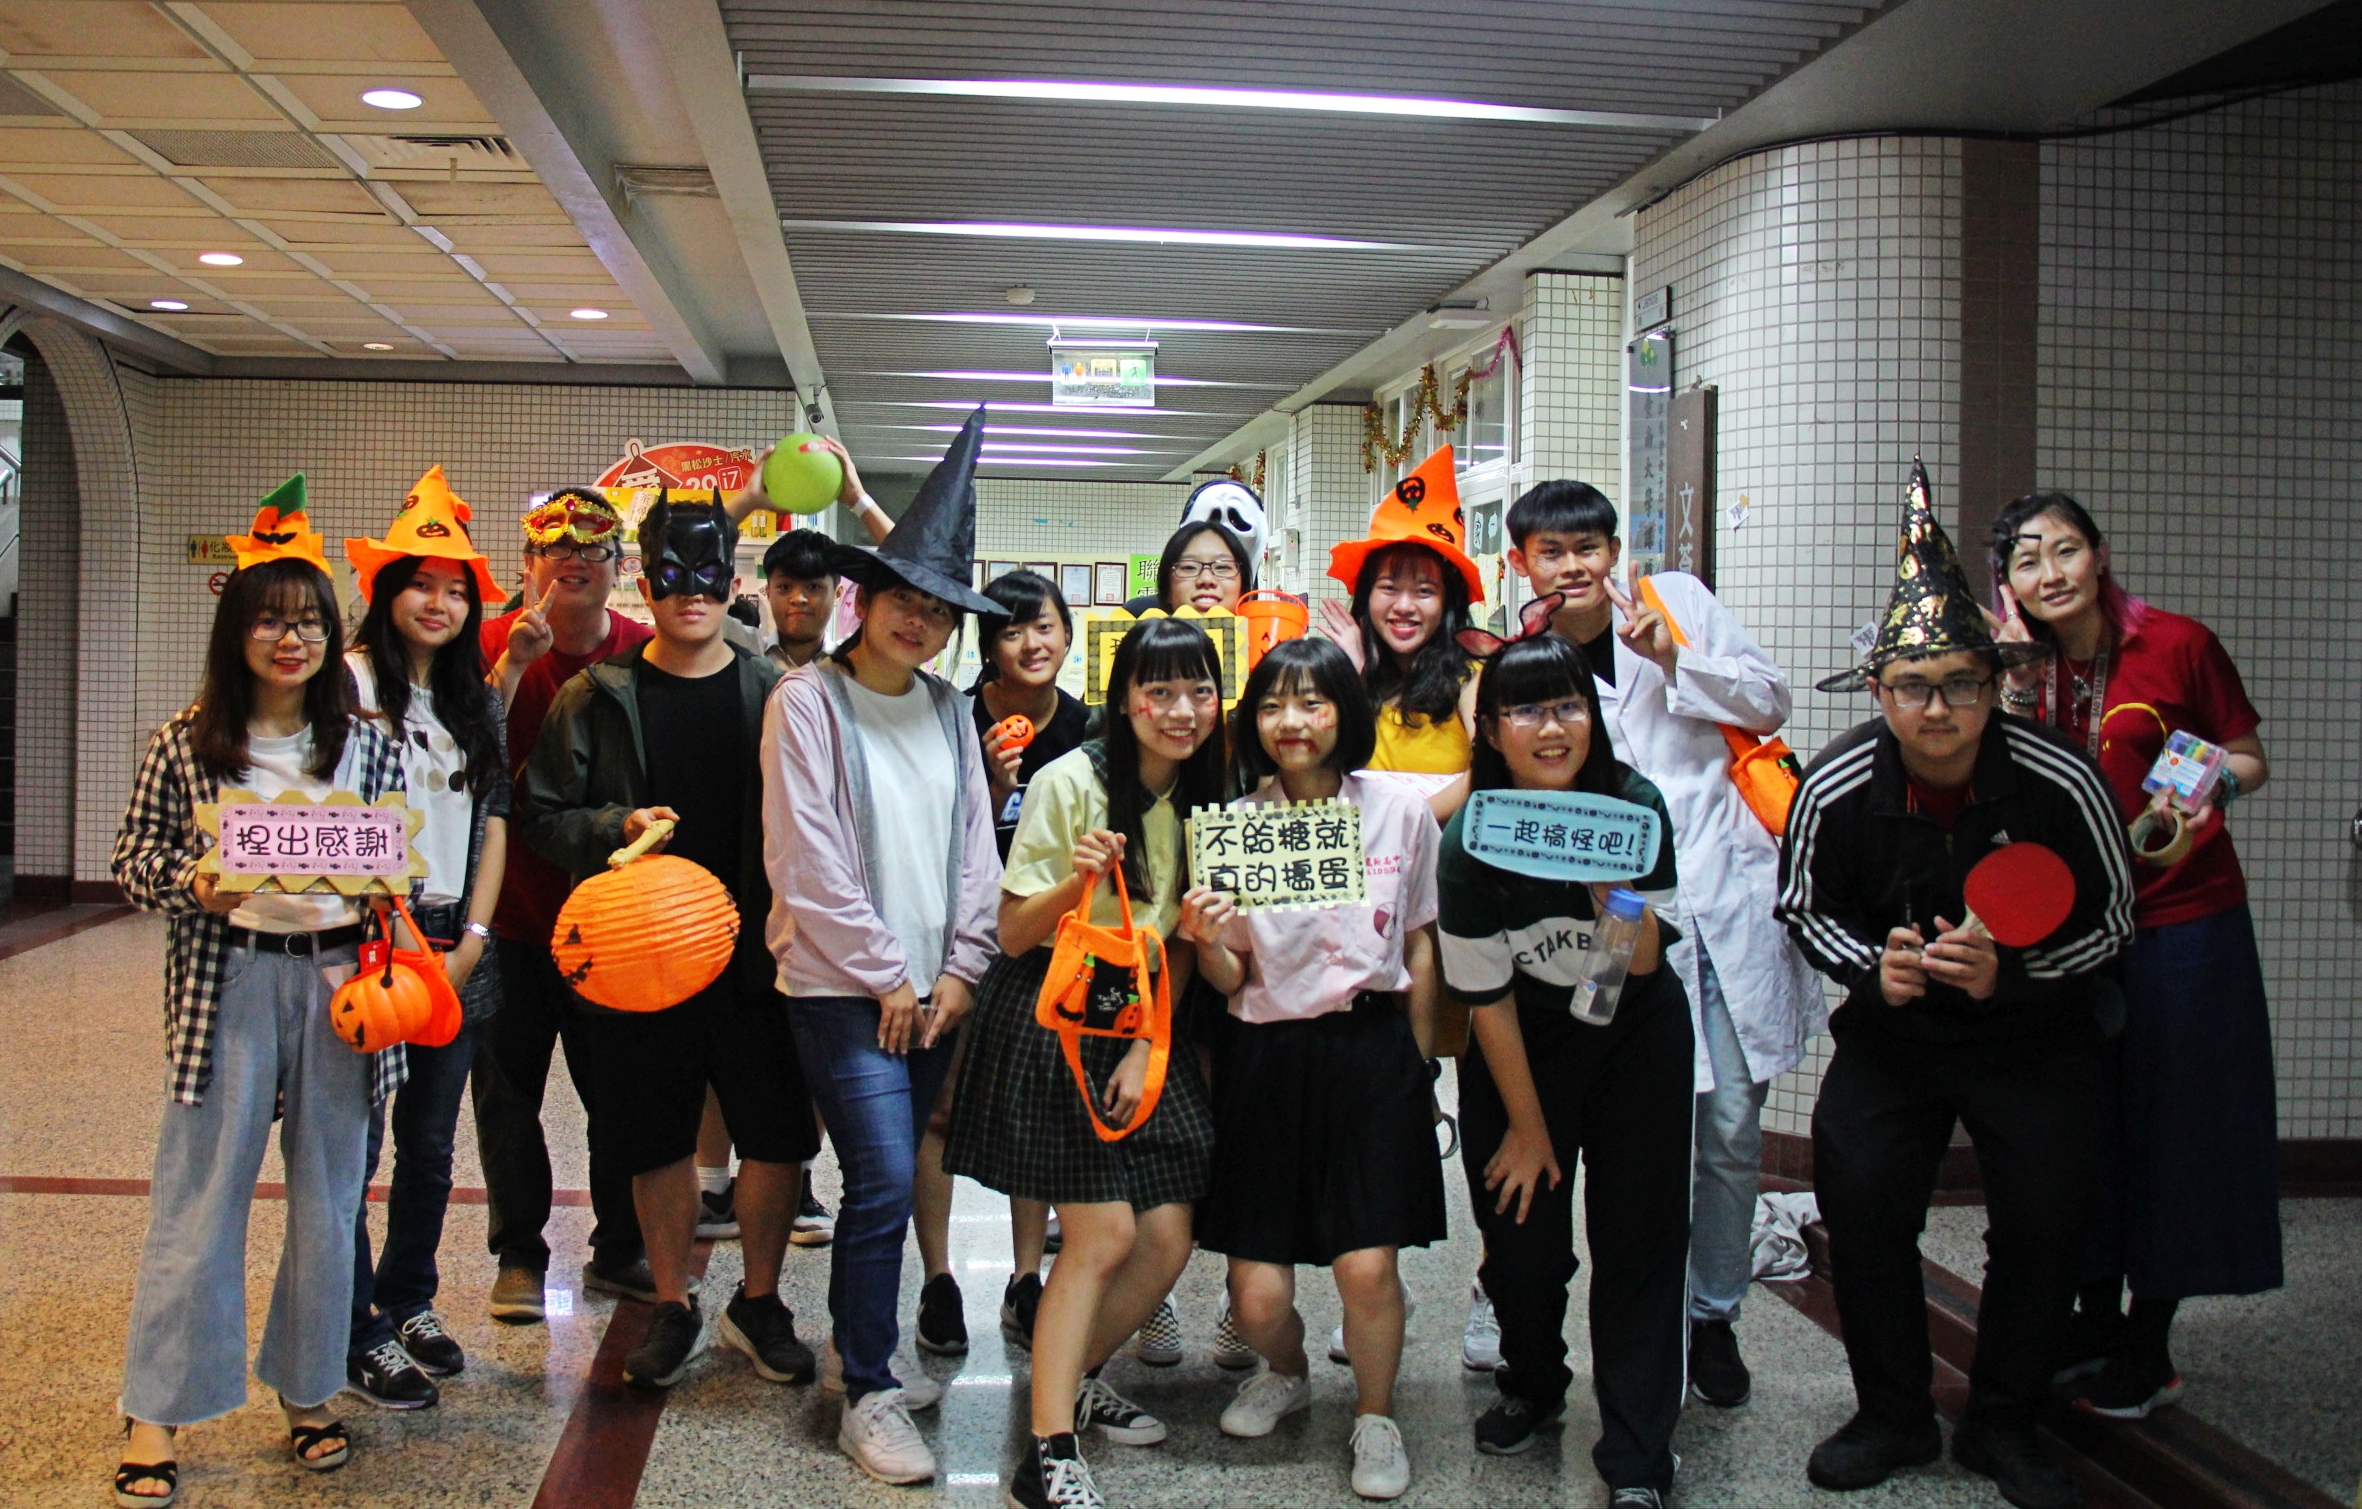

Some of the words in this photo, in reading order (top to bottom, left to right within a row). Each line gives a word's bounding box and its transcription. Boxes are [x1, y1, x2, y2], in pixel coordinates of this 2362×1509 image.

[236, 824, 389, 857] 捏出感謝
[1205, 817, 1350, 857] 不給糖就
[1486, 818, 1635, 857] 一起搞怪吧!
[1207, 856, 1350, 896] 真的搗蛋
